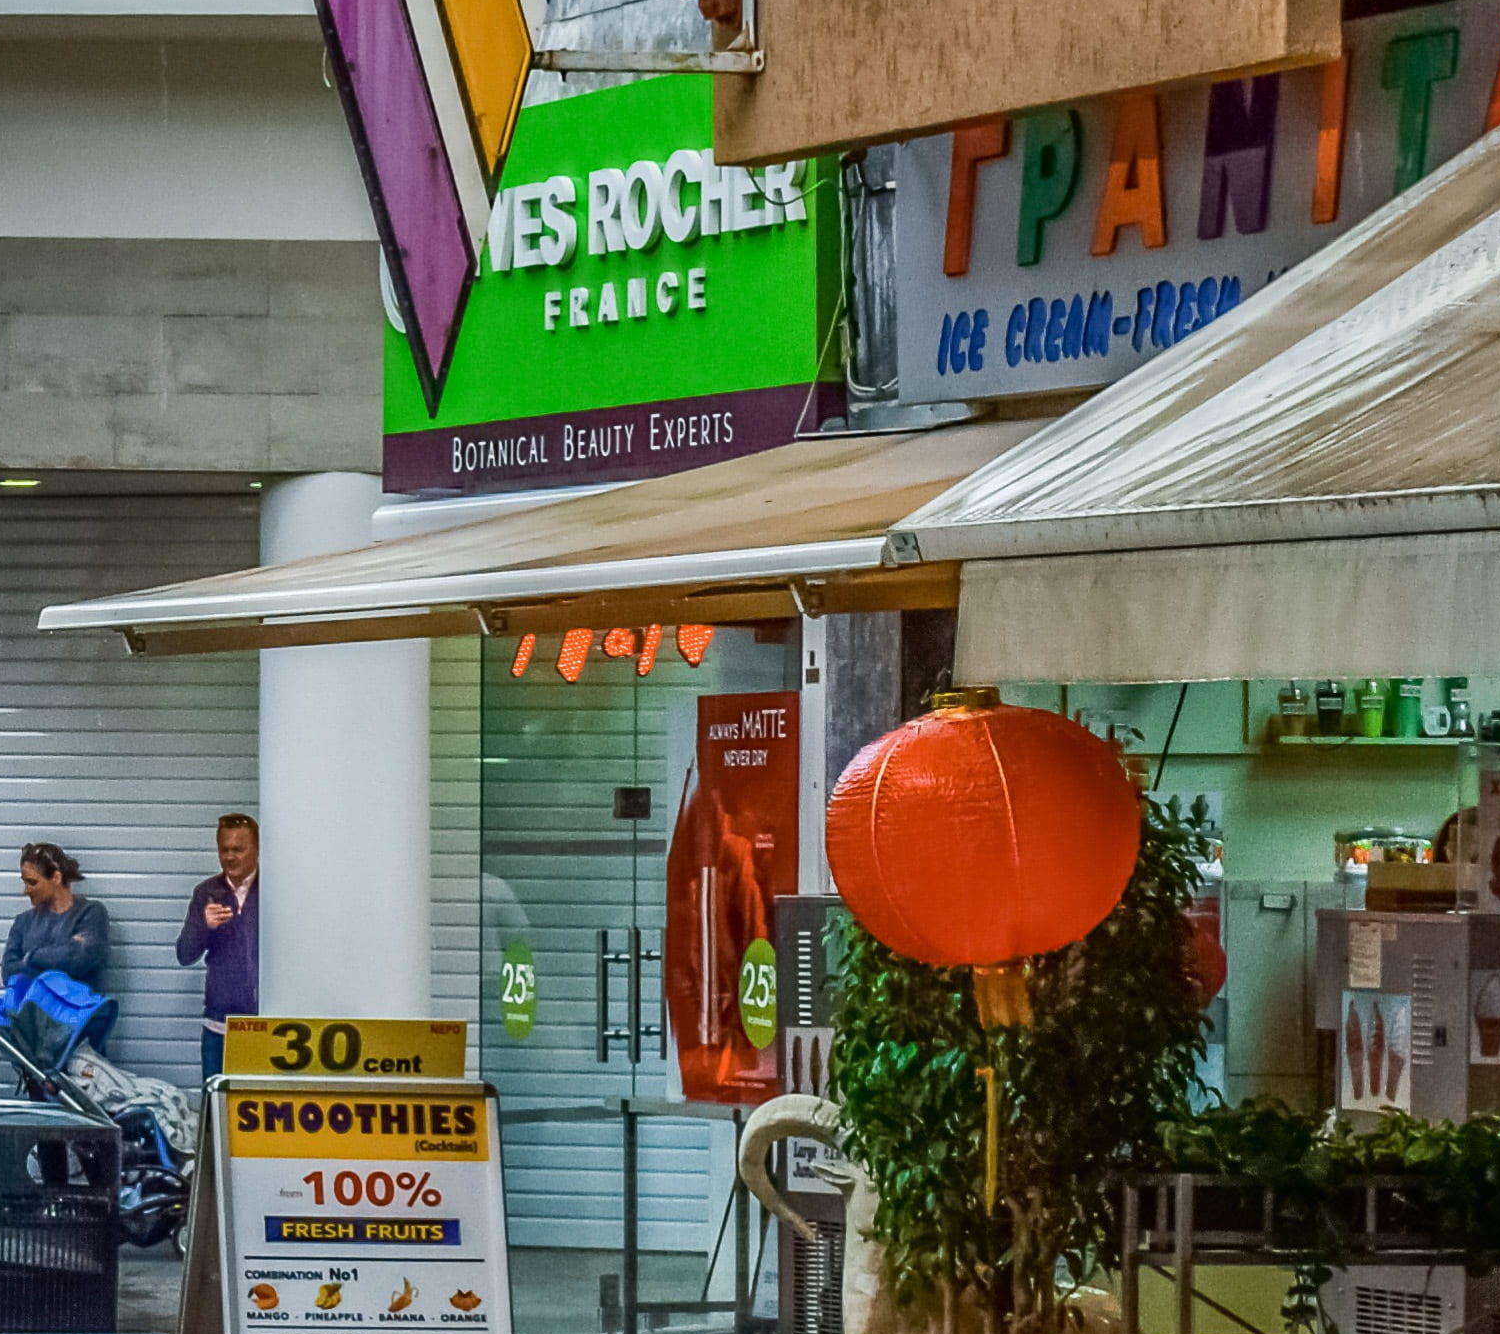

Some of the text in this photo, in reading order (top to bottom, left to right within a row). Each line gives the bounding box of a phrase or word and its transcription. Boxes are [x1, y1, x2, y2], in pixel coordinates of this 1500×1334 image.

[478, 150, 807, 274] VES ROCHER
[545, 268, 707, 331] FRANCE
[937, 308, 989, 376] ICE
[708, 709, 787, 740] ALWAYS MATTE
[723, 749, 768, 766] NEVER DRY
[229, 1021, 268, 1033] WATER
[269, 1022, 422, 1073] 30 cent
[237, 1100, 477, 1136] SMOOTHIES
[415, 1140, 478, 1153] (Cocktails)
[303, 1170, 442, 1208] 100%
[282, 1222, 444, 1240] FRESH FRUITS
[245, 1268, 359, 1281] COMBINATION No1
[247, 1312, 487, 1323] MANGO PINEAPPLE BANANA ORANGE
